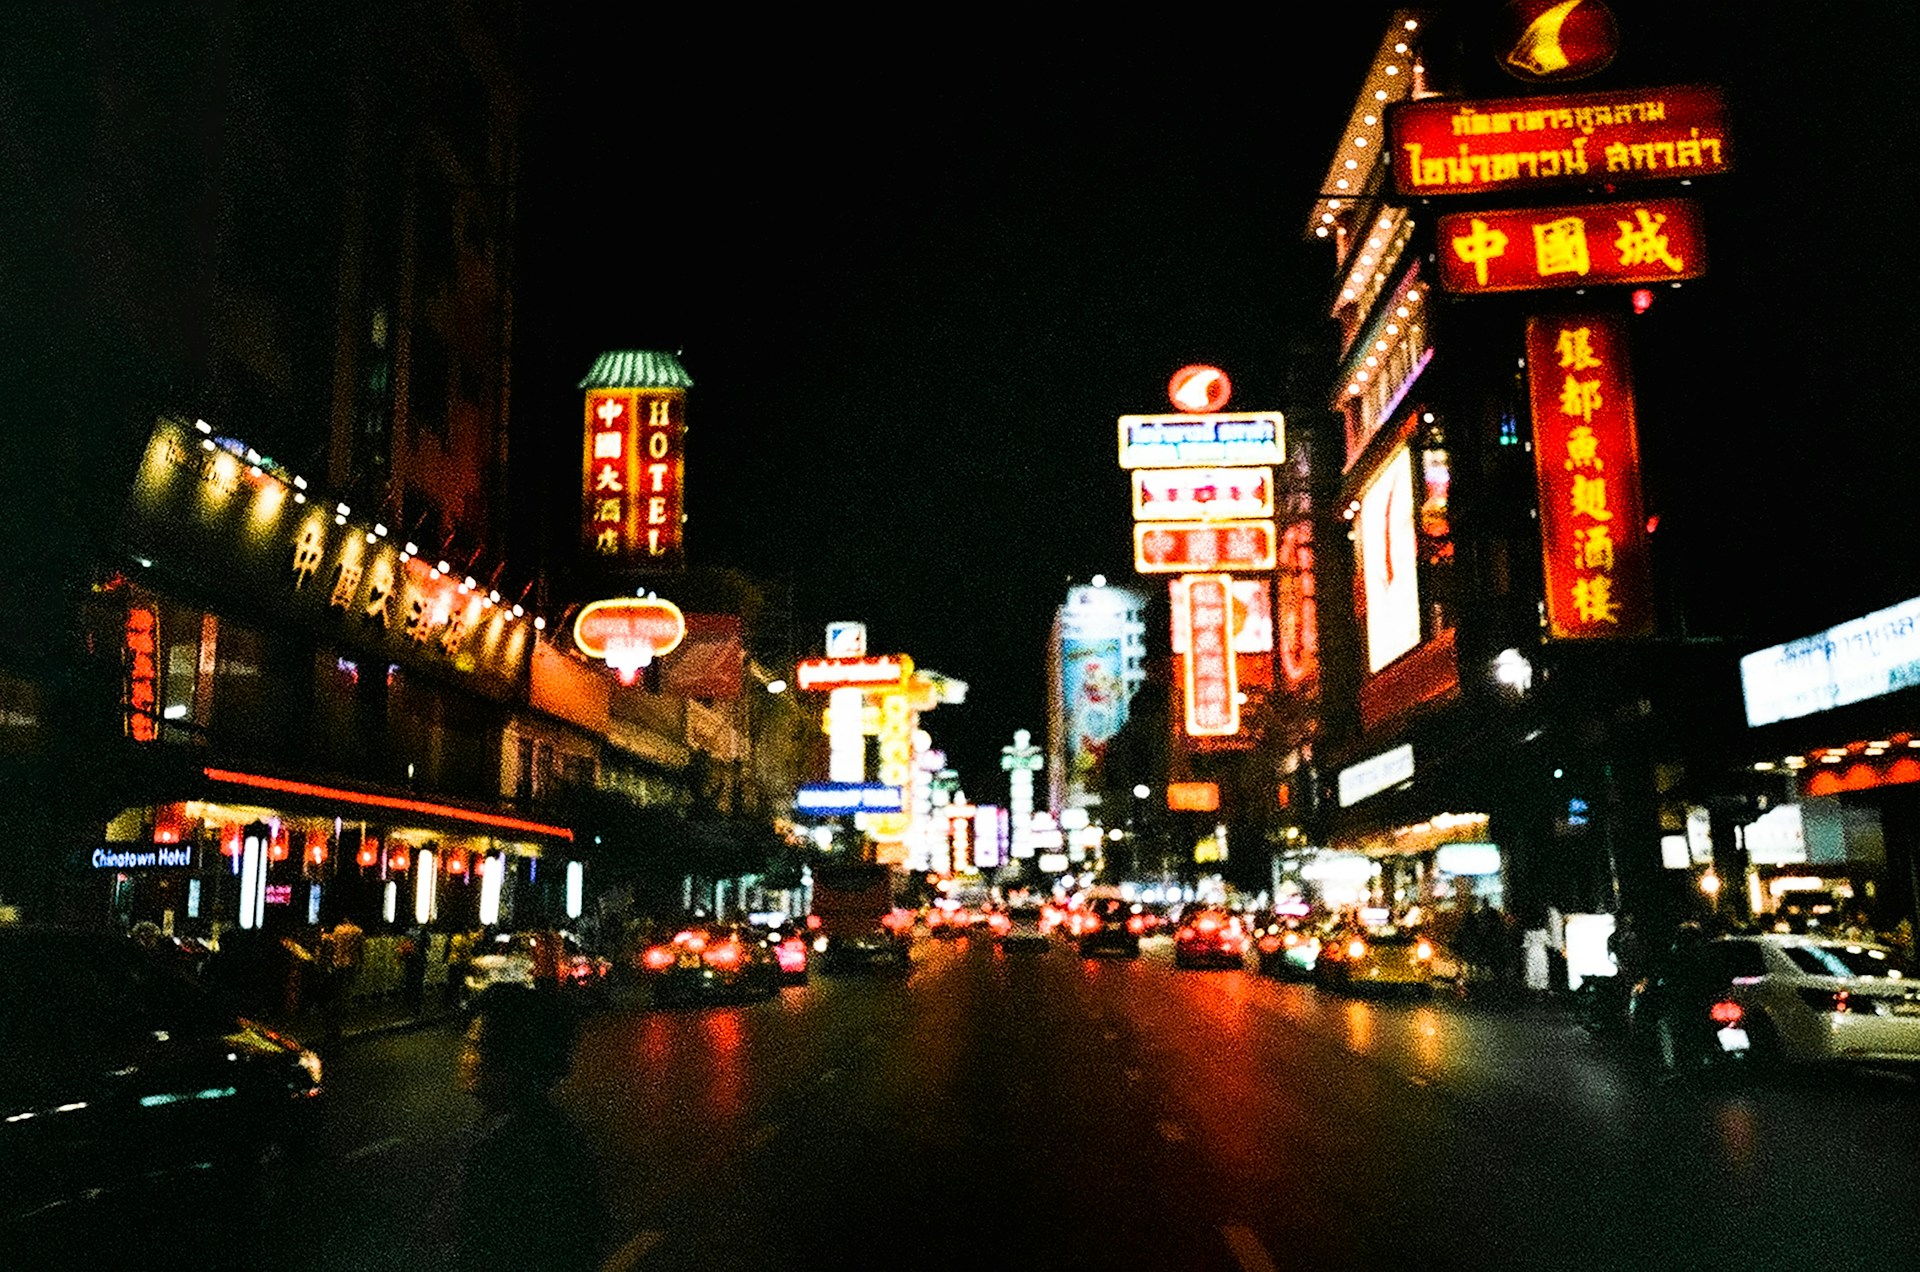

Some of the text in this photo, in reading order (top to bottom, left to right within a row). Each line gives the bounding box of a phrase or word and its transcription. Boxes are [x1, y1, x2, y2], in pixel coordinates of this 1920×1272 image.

[1452, 209, 1684, 286] 中國城
[648, 401, 669, 556] HOTEL
[91, 845, 191, 868] Chinatown Hotel
